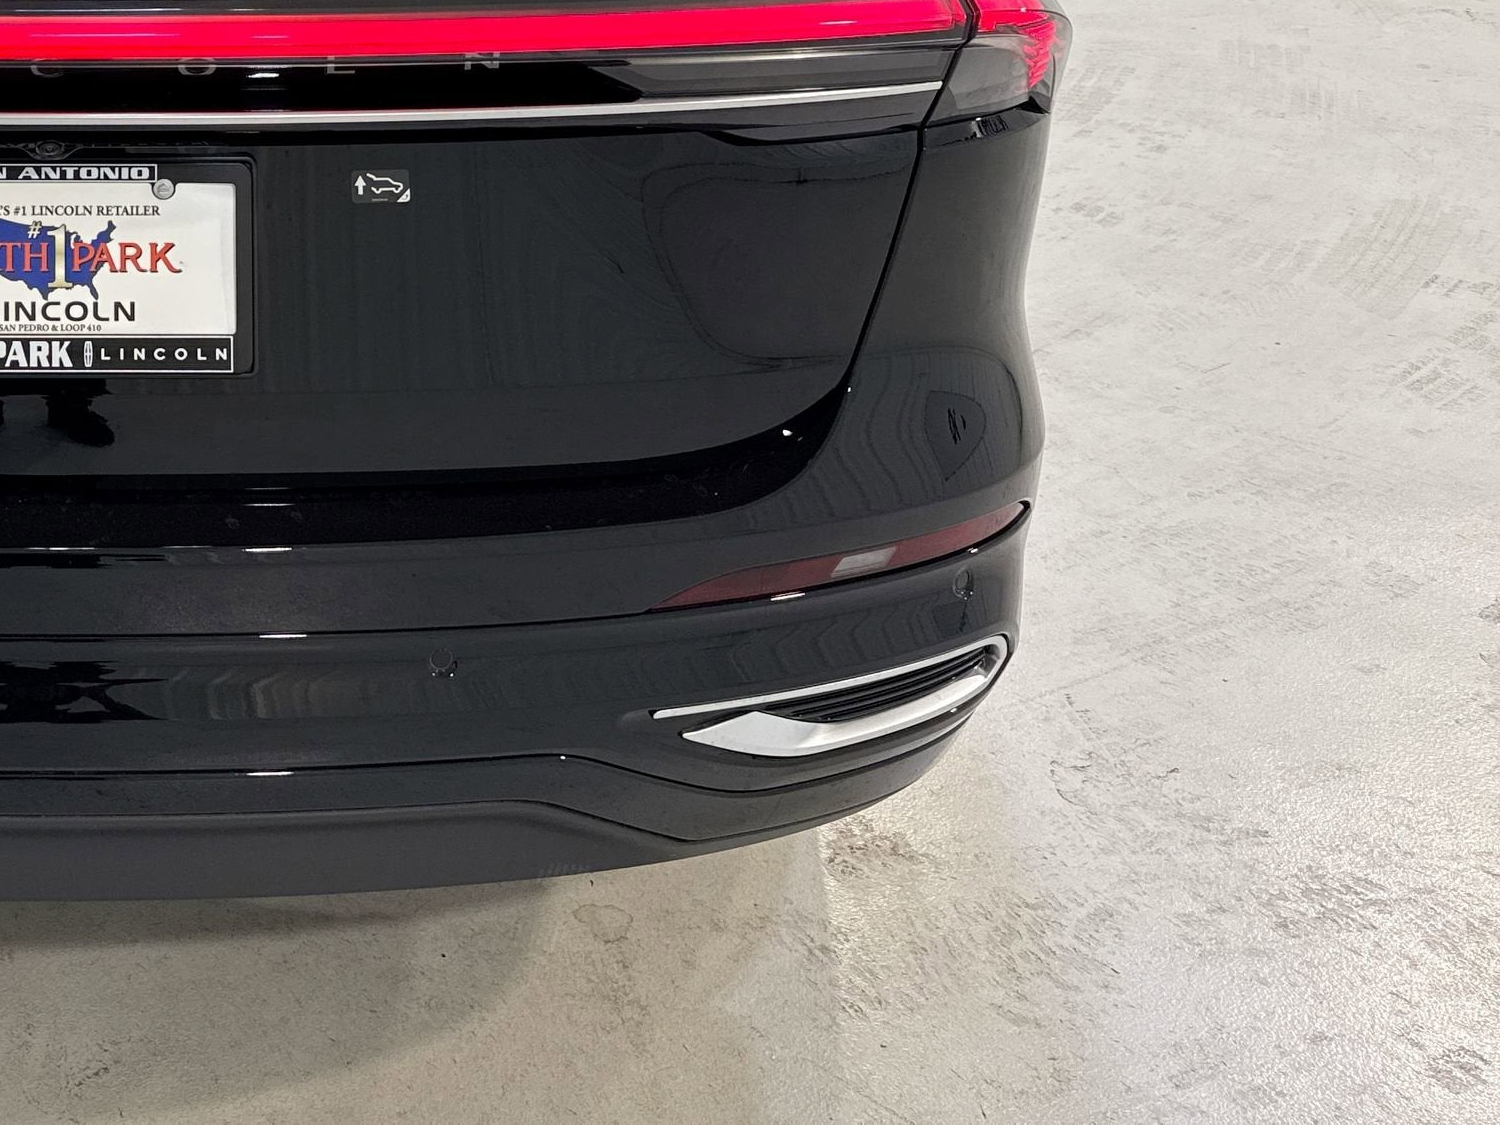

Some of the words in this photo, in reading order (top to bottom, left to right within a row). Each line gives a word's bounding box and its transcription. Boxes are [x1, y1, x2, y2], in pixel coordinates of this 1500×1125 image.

[17, 166, 150, 180] ANTONIO
[13, 206, 27, 216] #1
[31, 205, 93, 216] LINCOLN
[96, 205, 161, 216] RETAILER
[71, 242, 183, 274] PARK
[18, 324, 49, 332] PEDRO
[51, 324, 59, 332] &
[60, 324, 86, 332] LOOP
[87, 324, 102, 332] 410
[100, 347, 228, 361] LINCOLN
